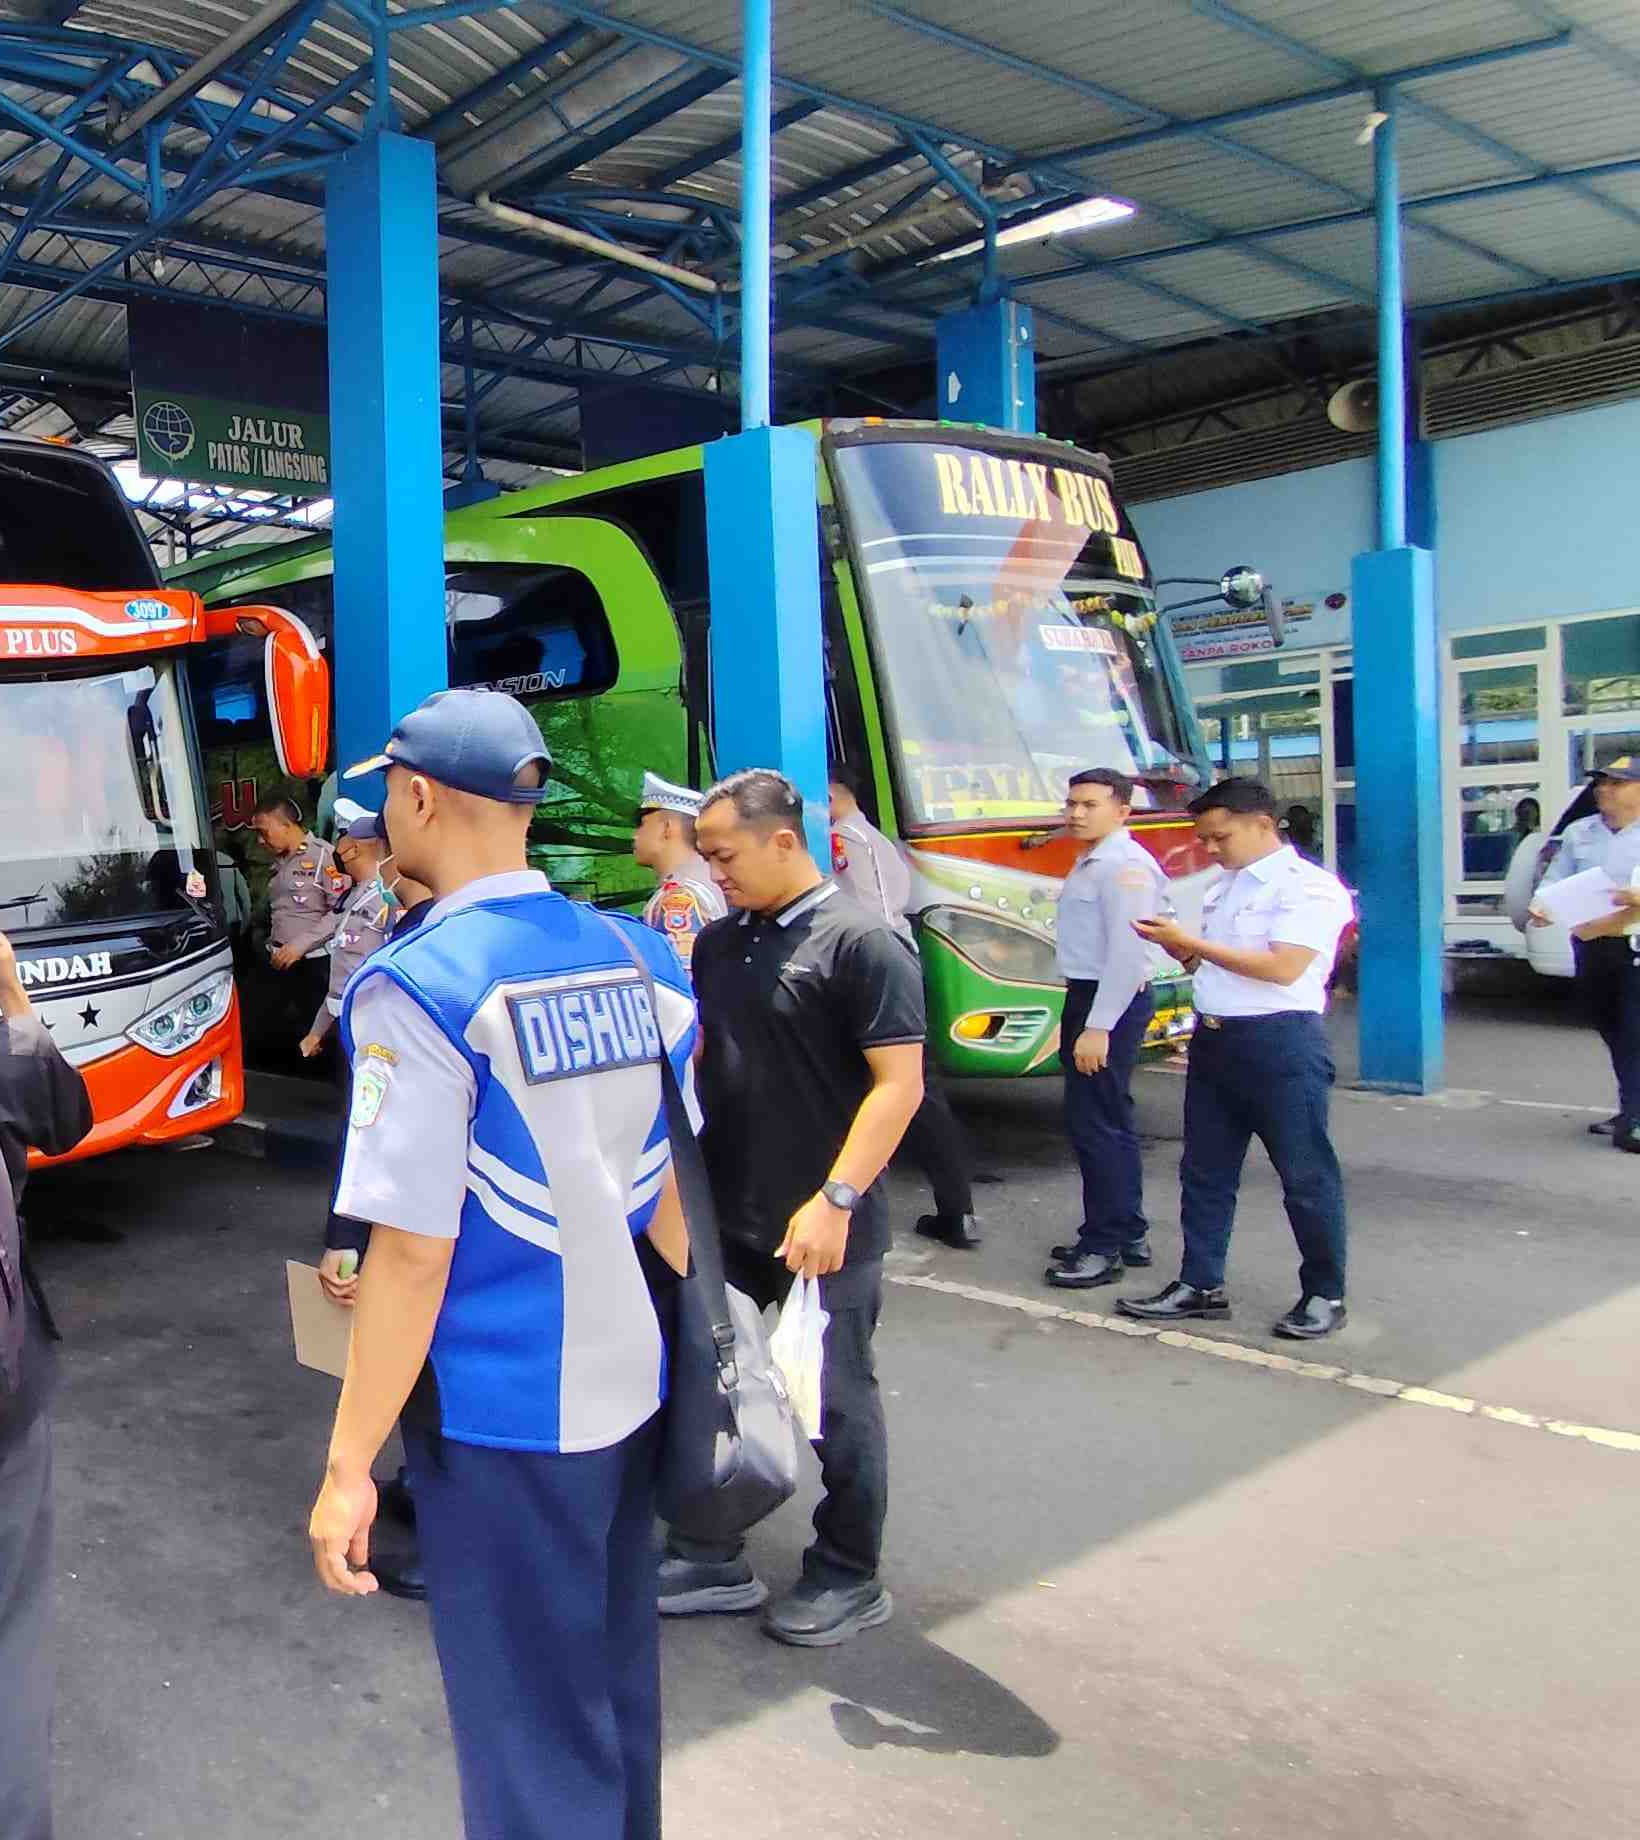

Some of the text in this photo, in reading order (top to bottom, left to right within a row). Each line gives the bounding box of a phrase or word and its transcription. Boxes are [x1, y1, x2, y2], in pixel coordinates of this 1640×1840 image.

[228, 416, 304, 448] JALUR
[208, 442, 250, 474] PATAS
[261, 449, 327, 483] LANGSUNG
[934, 453, 1118, 535] RALLY BUS
[4, 628, 78, 655] PLUS
[1228, 640, 1274, 652] ROKO
[515, 984, 661, 1075] DISHUB
